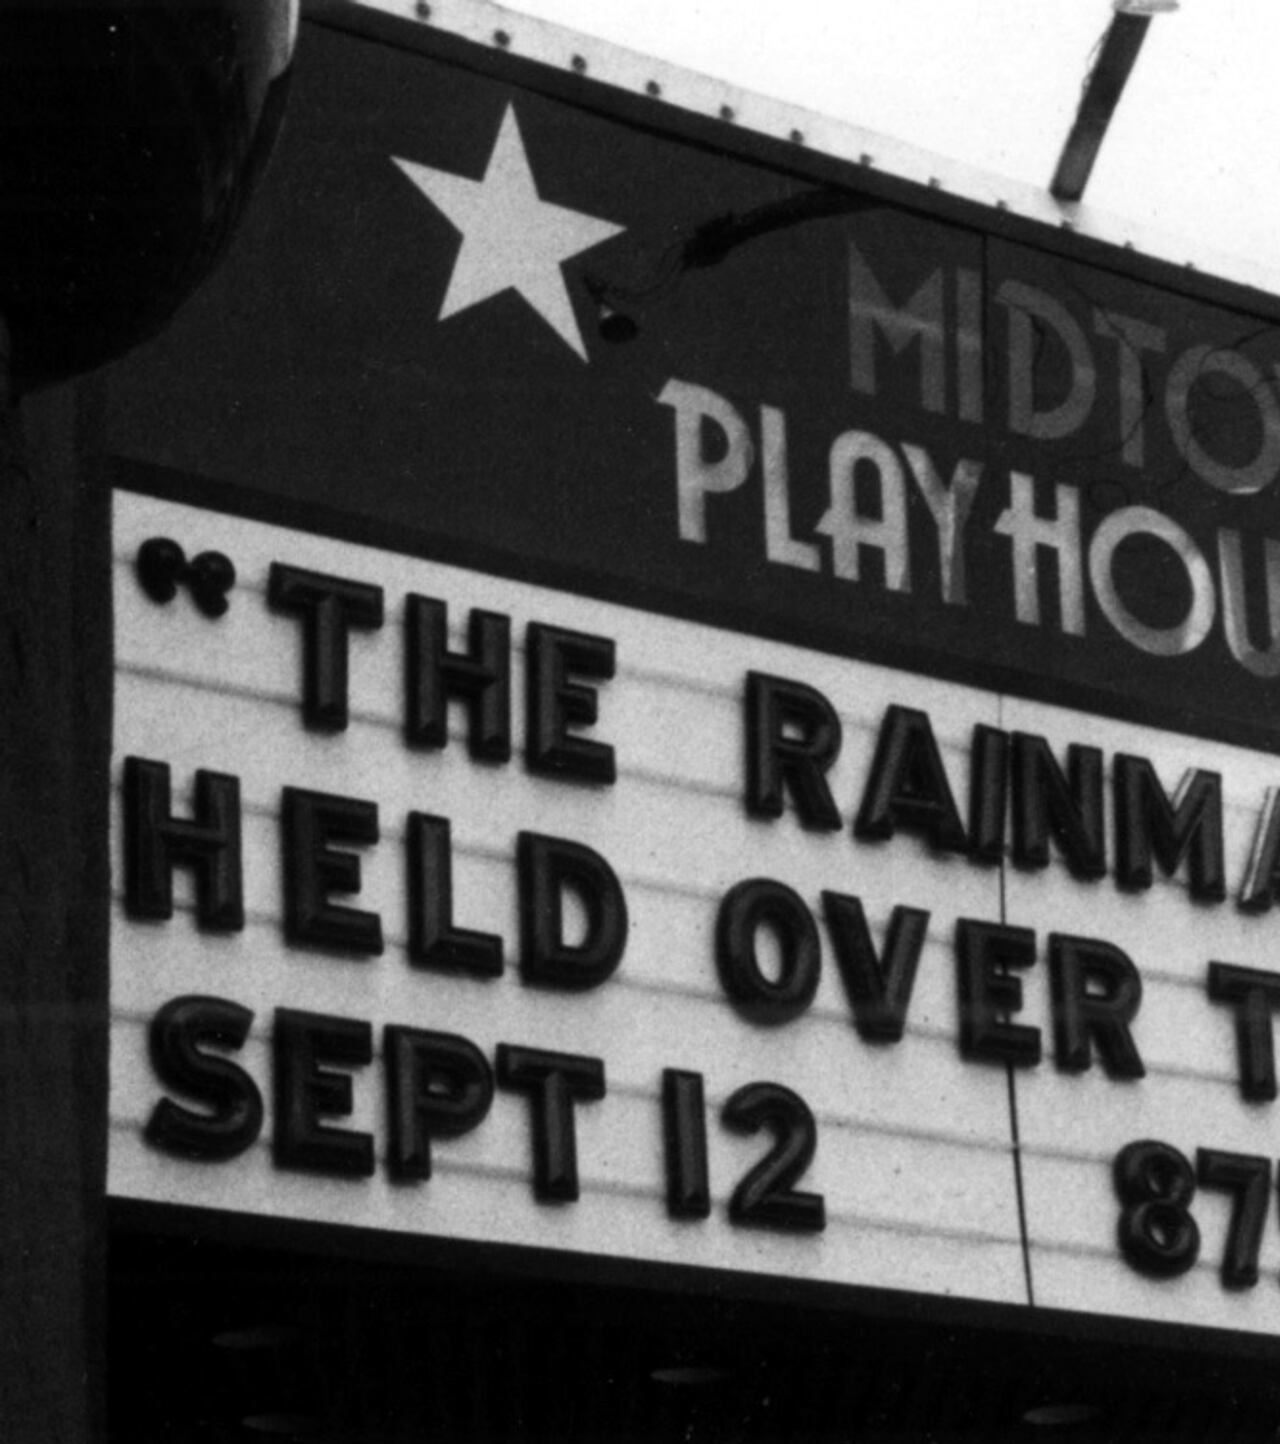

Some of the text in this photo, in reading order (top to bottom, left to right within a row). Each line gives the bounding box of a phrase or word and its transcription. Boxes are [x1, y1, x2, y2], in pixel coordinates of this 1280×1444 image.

[123, 755, 628, 993] HELD
[715, 878, 1146, 1080] OVER
[143, 994, 606, 1206] SEPT
[662, 1068, 826, 1235] 12
